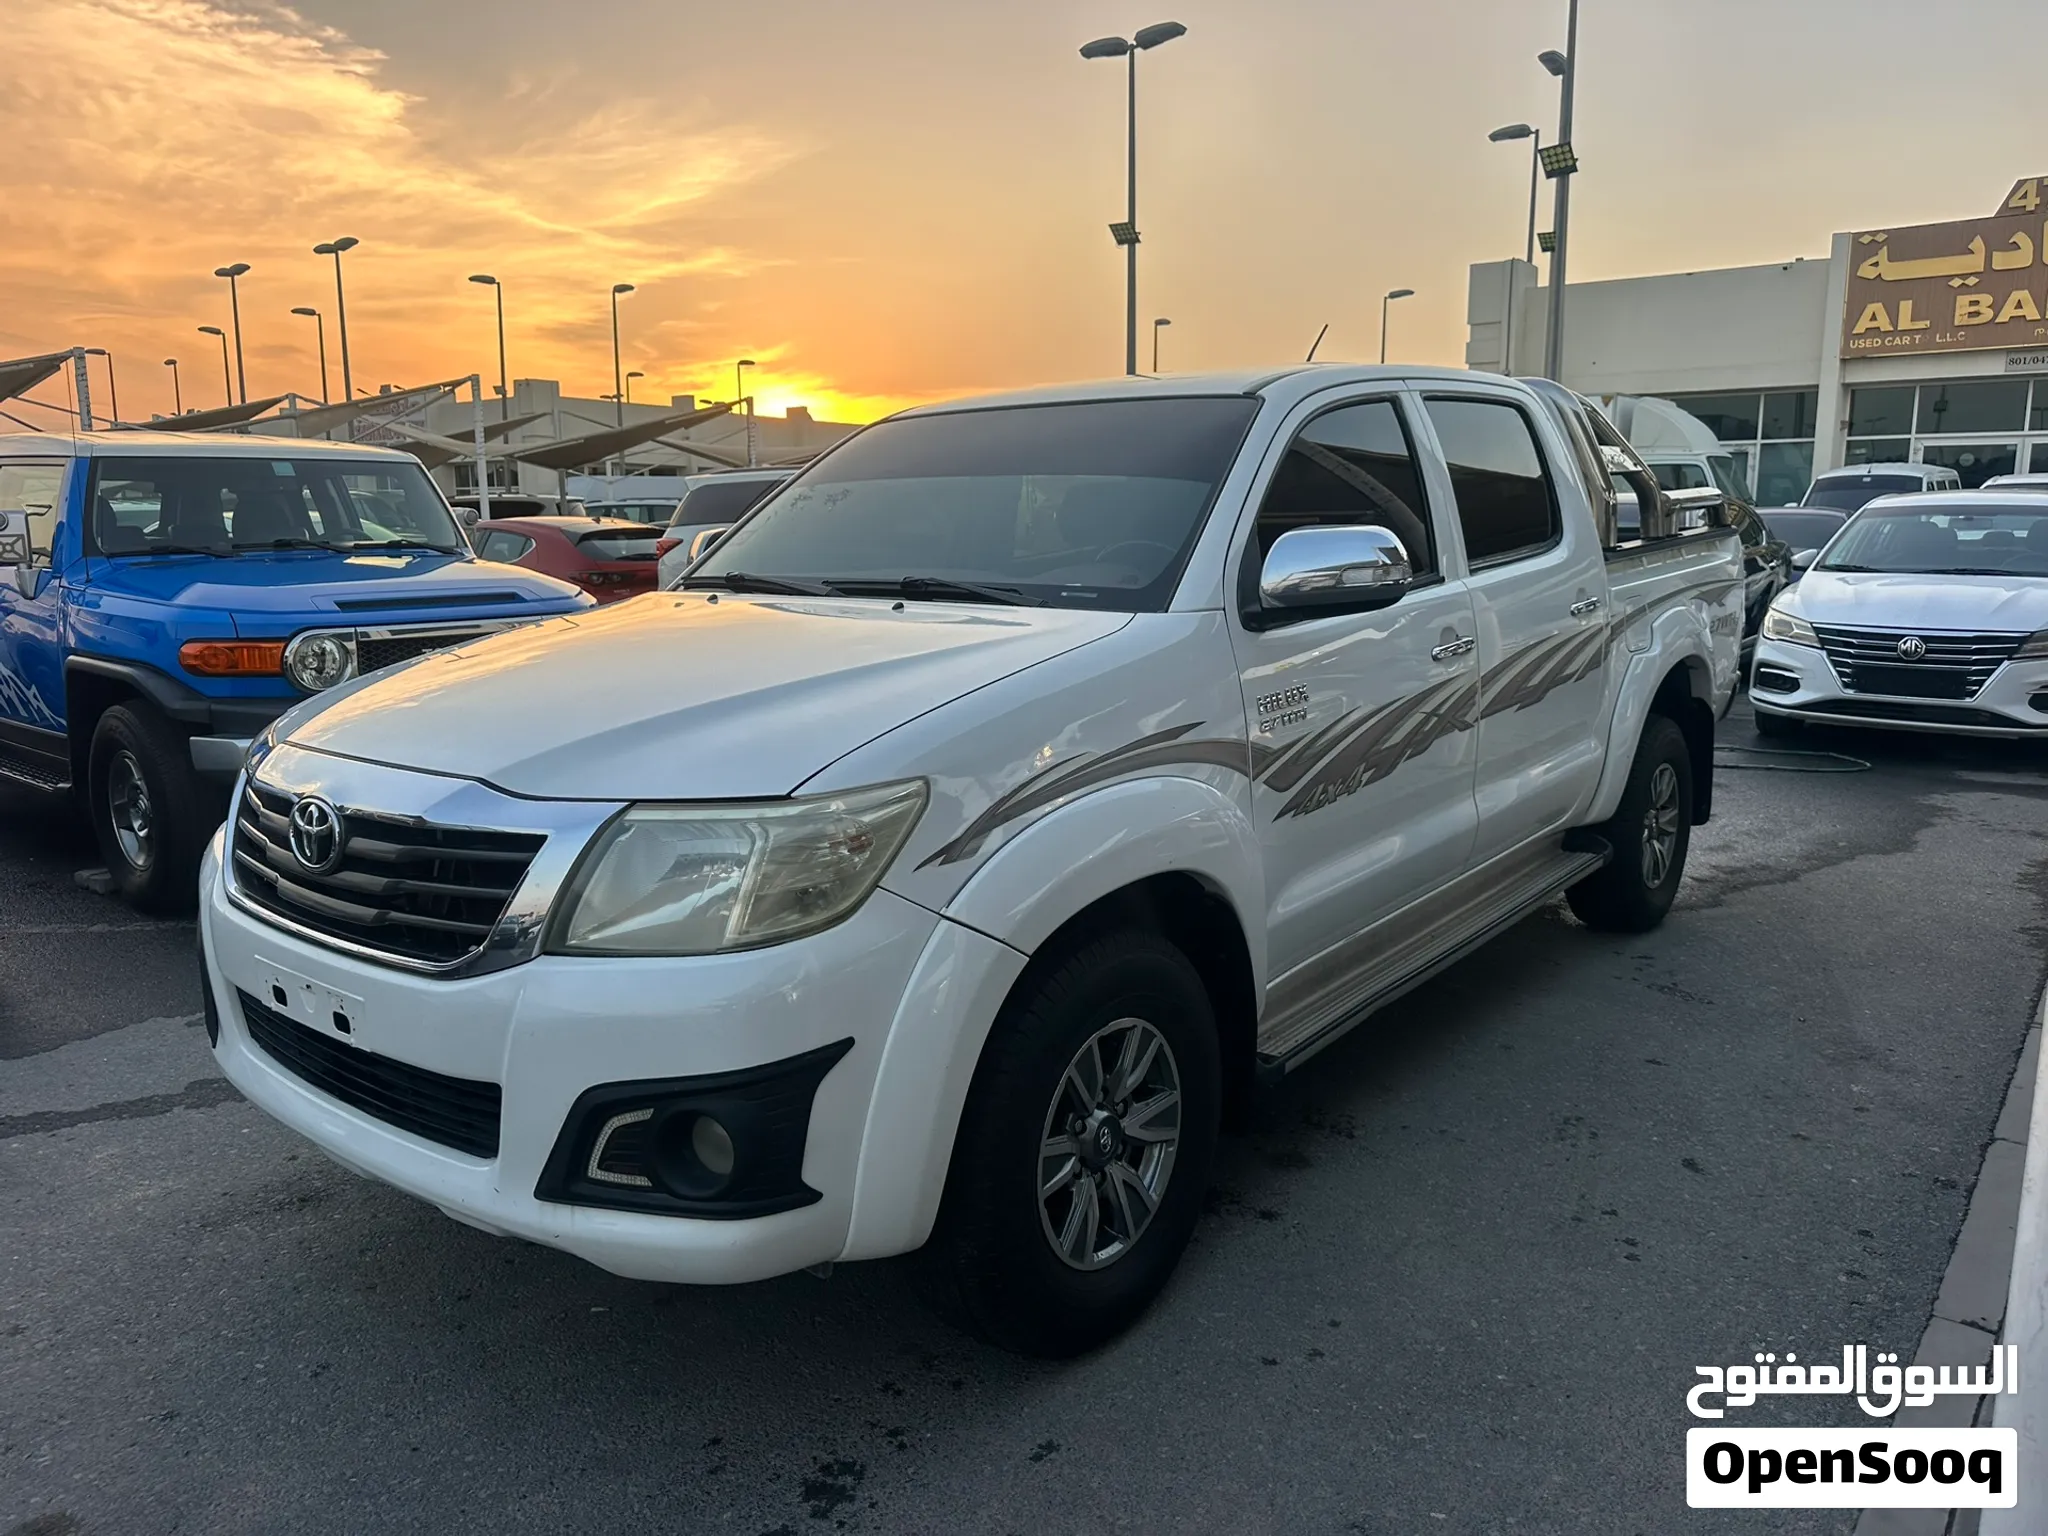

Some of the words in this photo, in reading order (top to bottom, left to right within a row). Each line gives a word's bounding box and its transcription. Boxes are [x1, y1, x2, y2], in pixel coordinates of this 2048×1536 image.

[2008, 178, 2048, 212] 4
[1852, 300, 1931, 335] AL
[1954, 289, 2048, 327] BA
[1849, 338, 1882, 349] USED
[1884, 336, 1911, 346] CAR
[1935, 331, 1966, 343] L.L.C
[1900, 638, 1923, 659] MG
[1256, 682, 1310, 716] HILUX
